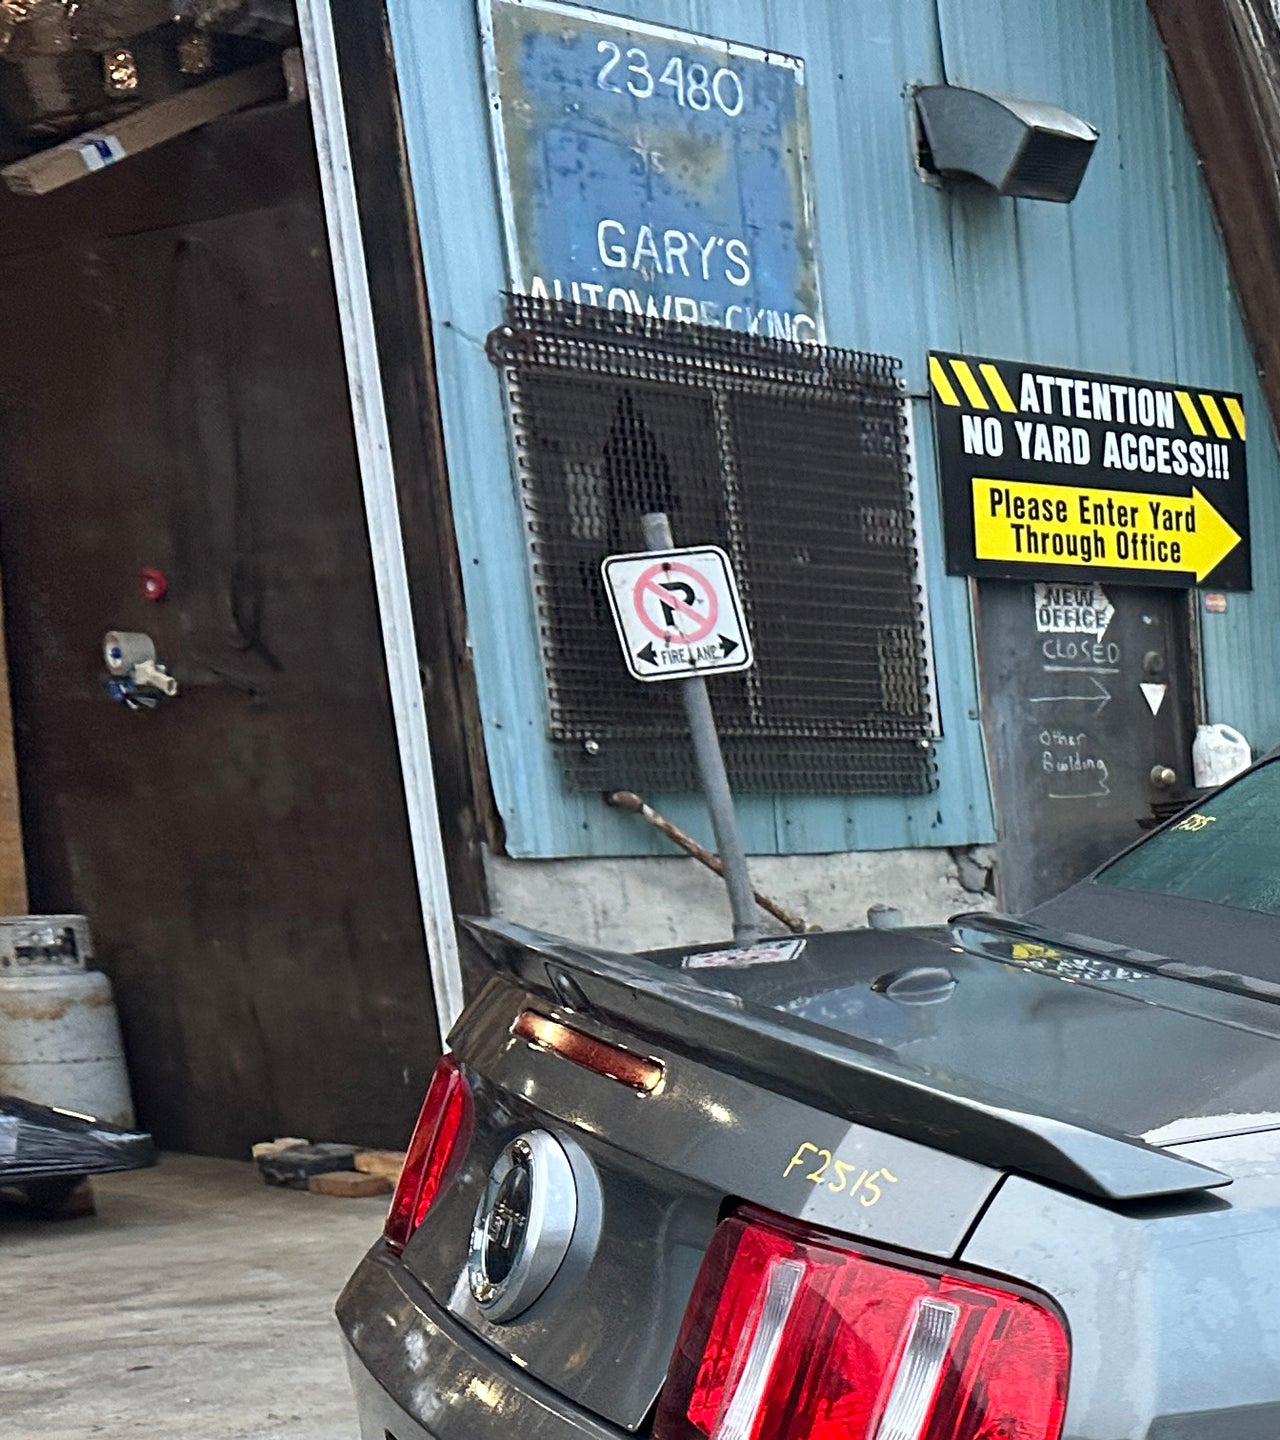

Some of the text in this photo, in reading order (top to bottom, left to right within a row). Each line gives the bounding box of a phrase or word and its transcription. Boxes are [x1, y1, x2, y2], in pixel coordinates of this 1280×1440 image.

[597, 40, 743, 117] 23480
[597, 219, 750, 288] GARY'S
[1019, 372, 1176, 430] ATTENTION
[961, 414, 1231, 481] NO YARD ACCESS!!!
[989, 487, 1197, 533] Please Enter Yard
[1010, 523, 1182, 564] Through Office
[1044, 588, 1094, 606] NEW
[1039, 607, 1107, 629] OFFICE
[660, 647, 685, 666] FIRE
[1042, 638, 1120, 664] CLOSED
[1040, 730, 1086, 746] Other
[1042, 750, 1108, 780] Building
[782, 1140, 898, 1207] F2515
